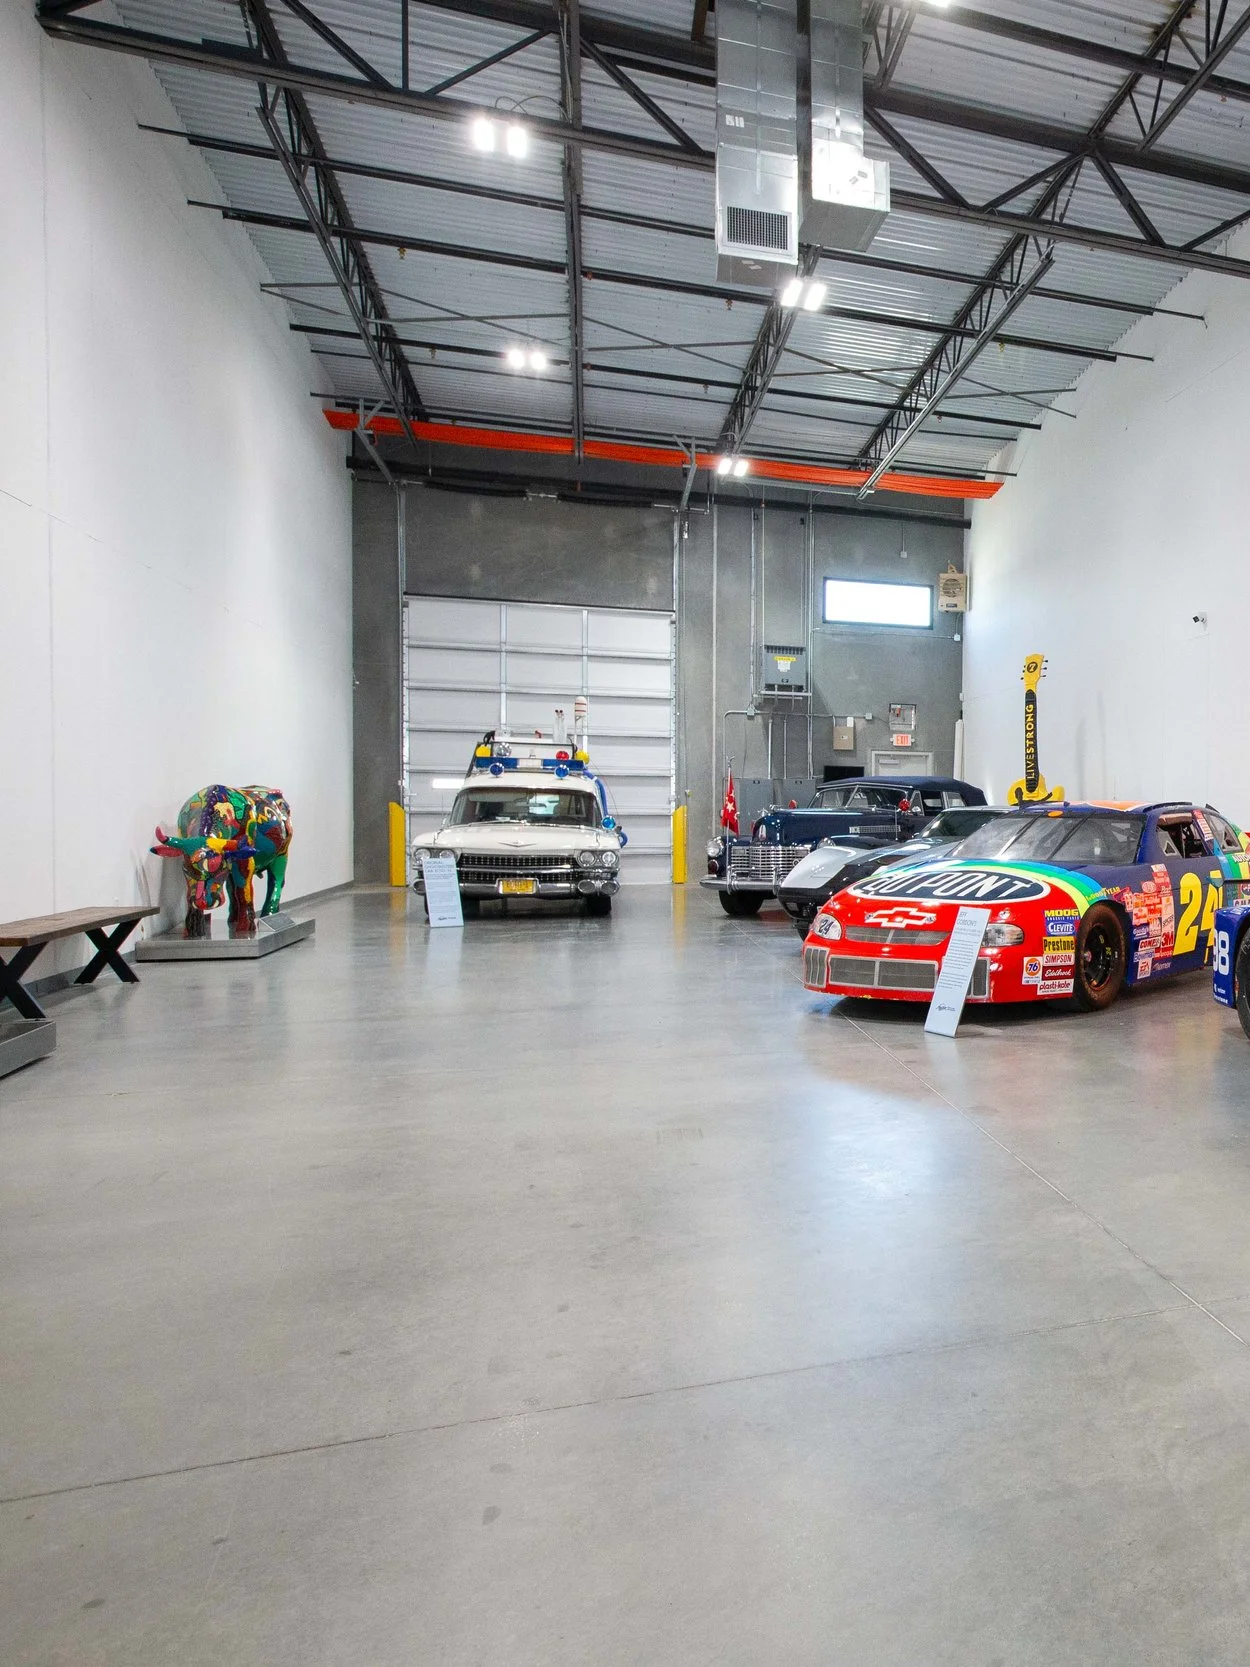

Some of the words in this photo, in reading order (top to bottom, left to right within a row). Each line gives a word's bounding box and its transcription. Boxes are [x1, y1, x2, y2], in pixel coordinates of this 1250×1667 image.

[896, 735, 909, 745] EXIT
[1026, 703, 1035, 780] LIVESTRONG
[1044, 908, 1079, 917] MOOG
[1172, 871, 1223, 956] 24
[818, 918, 833, 936] 24
[1048, 922, 1073, 933] CLEVITE
[1043, 938, 1075, 951] Prestone
[1044, 954, 1073, 964] SIMPSON
[1028, 962, 1039, 972] 76
